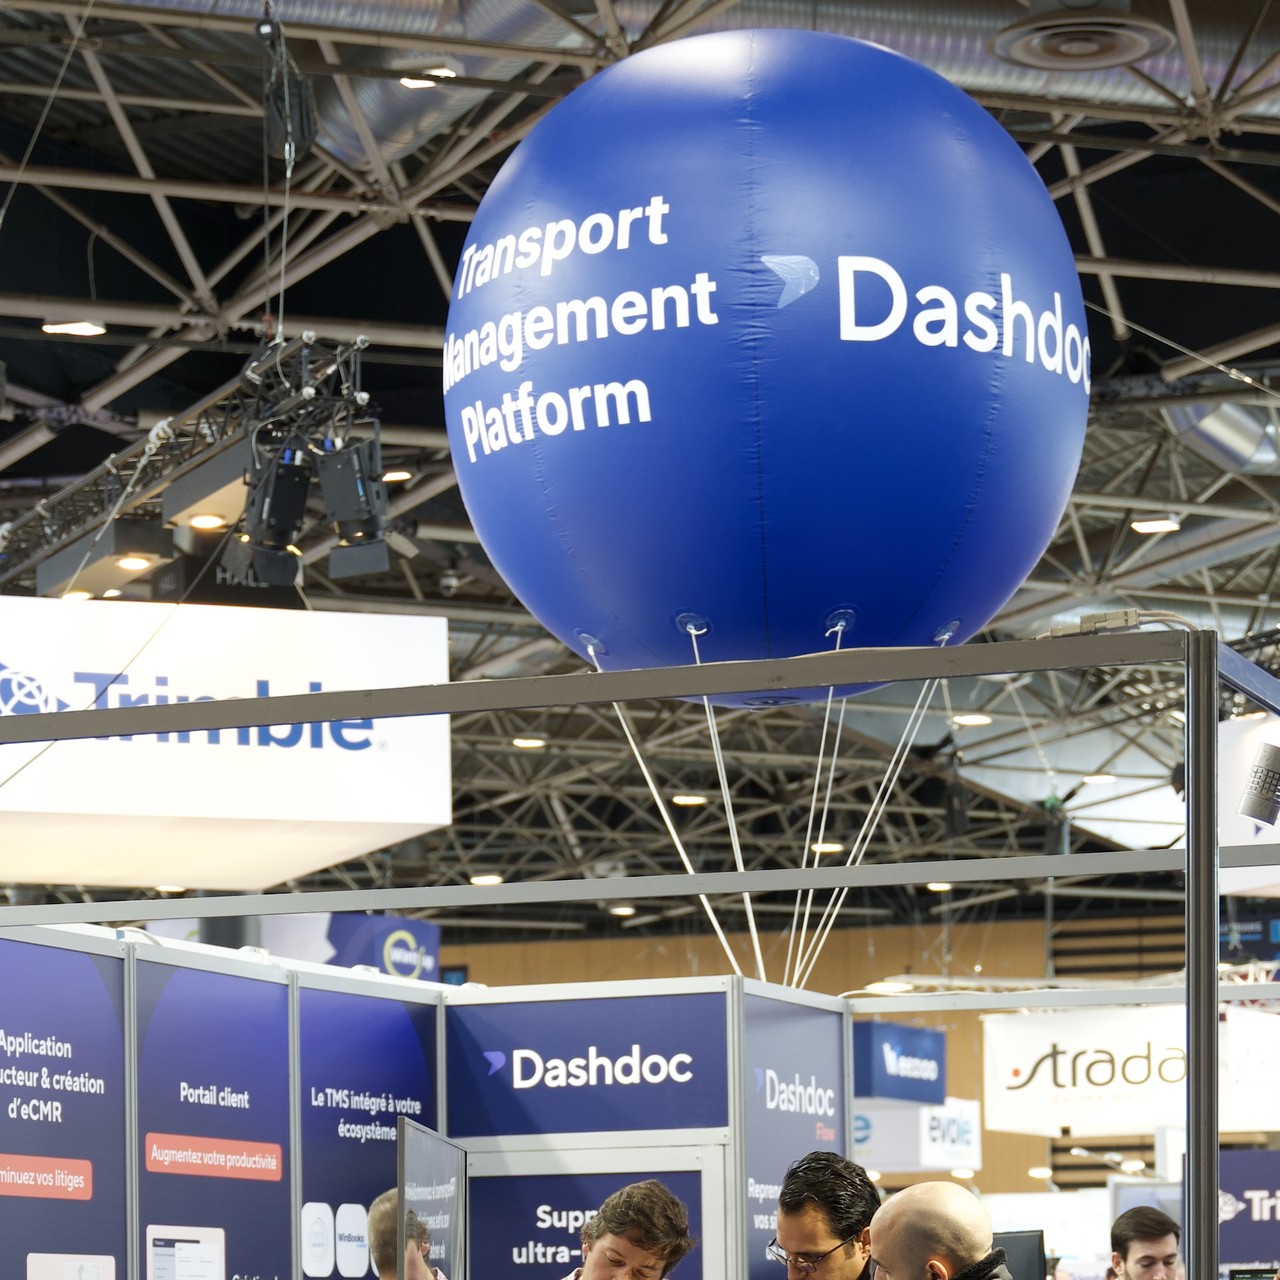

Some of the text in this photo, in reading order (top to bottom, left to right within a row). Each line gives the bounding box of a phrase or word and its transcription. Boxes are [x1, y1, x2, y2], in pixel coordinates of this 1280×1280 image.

[458, 195, 669, 299] Transport
[443, 272, 719, 396] Management
[837, 255, 1092, 396] Dashdoc
[462, 379, 652, 463] Platform
[74, 669, 375, 751] Tible
[513, 1044, 692, 1089] Dashdoc
[41, 1067, 51, 1089] &
[53, 1070, 104, 1094] création
[765, 1069, 835, 1117] Dashdoc
[180, 1081, 249, 1109] Portail client
[311, 1087, 421, 1115] Le TMS intégré à votre
[8, 1098, 62, 1122] d'eCMR
[338, 1118, 397, 1143] écosystème
[816, 1122, 835, 1141] Flow
[151, 1144, 277, 1170] Augmentez votre productivité
[36, 1174, 53, 1186] vos
[55, 1170, 84, 1191] litiges
[753, 1214, 769, 1229] vos
[338, 1233, 364, 1243] WinBooks
[513, 1241, 585, 1264] ultra-
